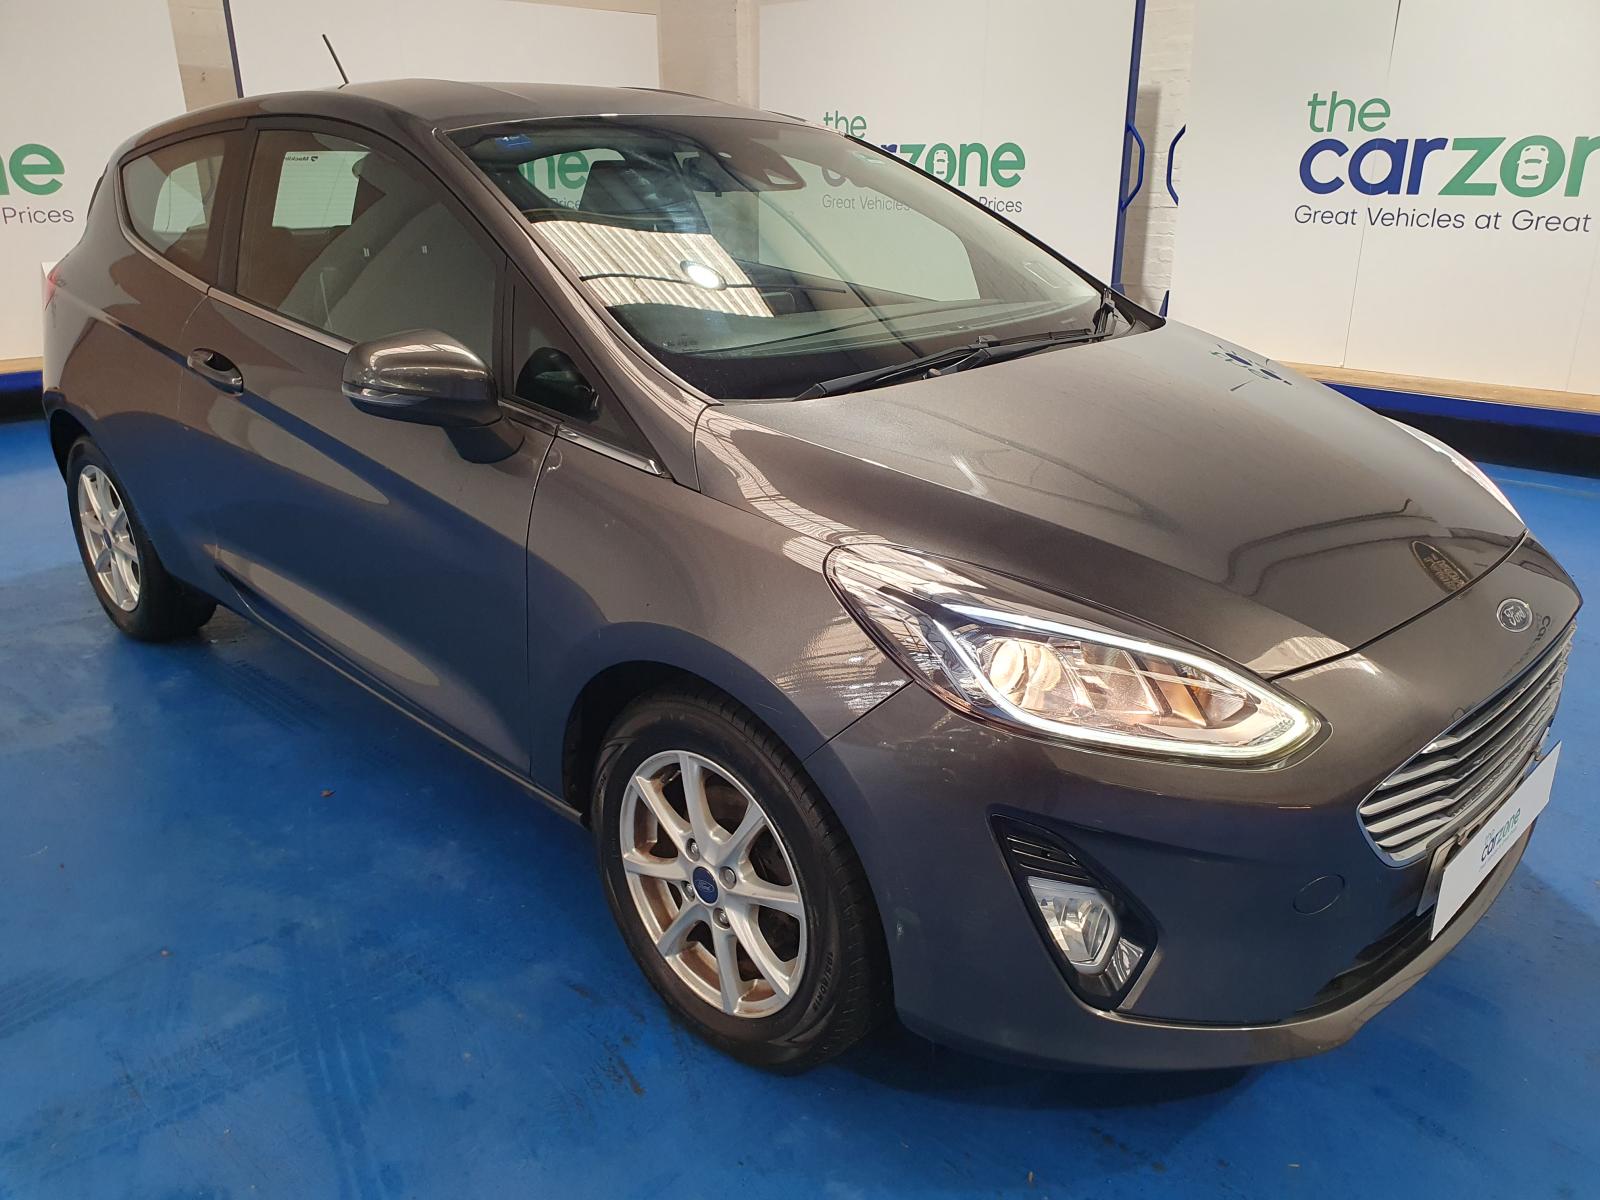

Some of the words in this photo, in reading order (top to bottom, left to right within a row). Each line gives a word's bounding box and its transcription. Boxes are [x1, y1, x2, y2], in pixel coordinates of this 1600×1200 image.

[823, 110, 867, 139] the
[1307, 90, 1391, 133] the
[2, 206, 74, 225] Prices
[822, 194, 856, 209] Great
[1294, 204, 1358, 226] Great
[1367, 207, 1466, 229] Vehicles
[1474, 210, 1503, 231] at
[1511, 209, 1592, 233] Great
[1480, 807, 1522, 863] carzone
